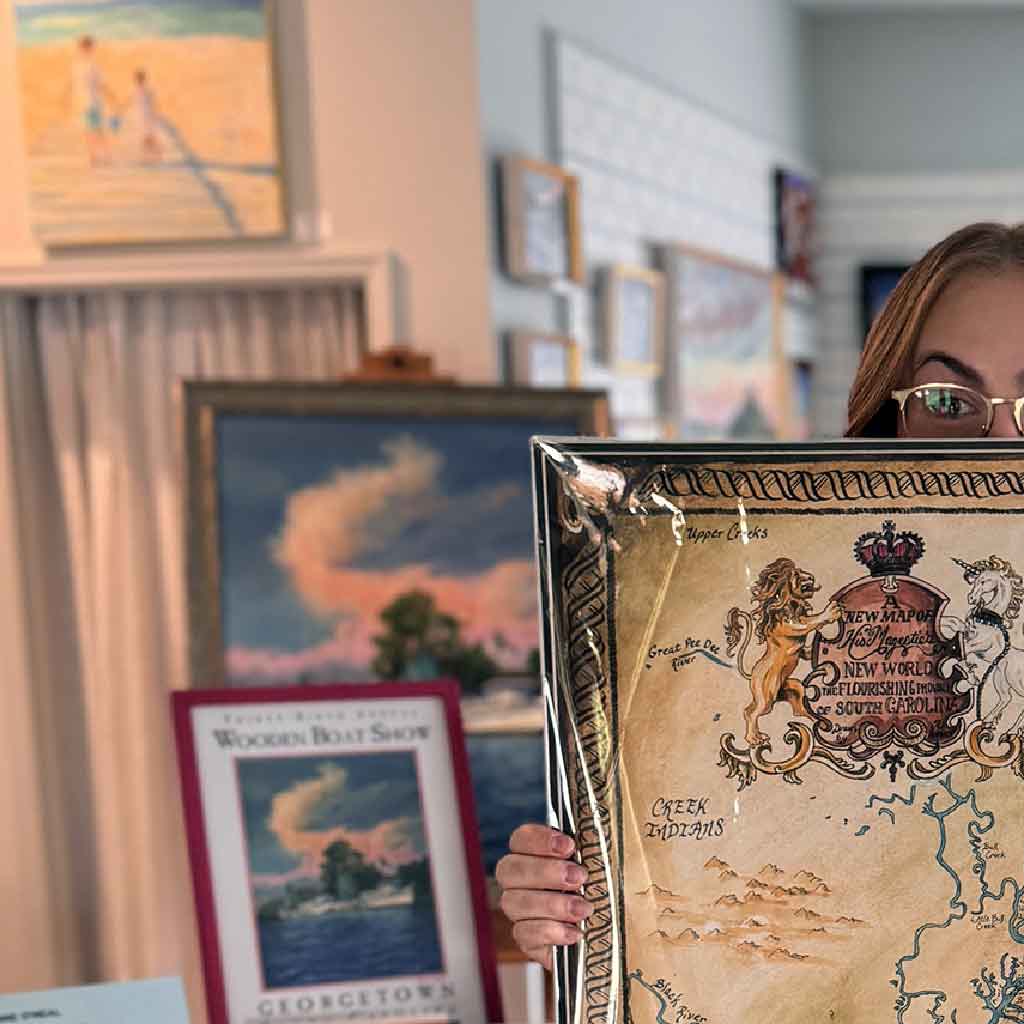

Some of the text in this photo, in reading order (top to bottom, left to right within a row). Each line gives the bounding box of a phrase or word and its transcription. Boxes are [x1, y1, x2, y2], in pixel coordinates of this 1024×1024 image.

[687, 522, 768, 543] Upper Creks
[845, 610, 879, 624] NEW
[881, 610, 917, 623] MAP
[648, 644, 681, 659] Great
[685, 637, 701, 650] Pee
[671, 655, 697, 672] River
[843, 660, 934, 679] NEW WORLD
[835, 701, 880, 716] SOUTH
[213, 720, 431, 749] WOODEN BOAT SHOW
[652, 798, 710, 822] CREEK
[645, 817, 724, 841] INDIANS
[256, 984, 456, 1017] GEORGETOWN
[655, 979, 708, 1024] Black River
